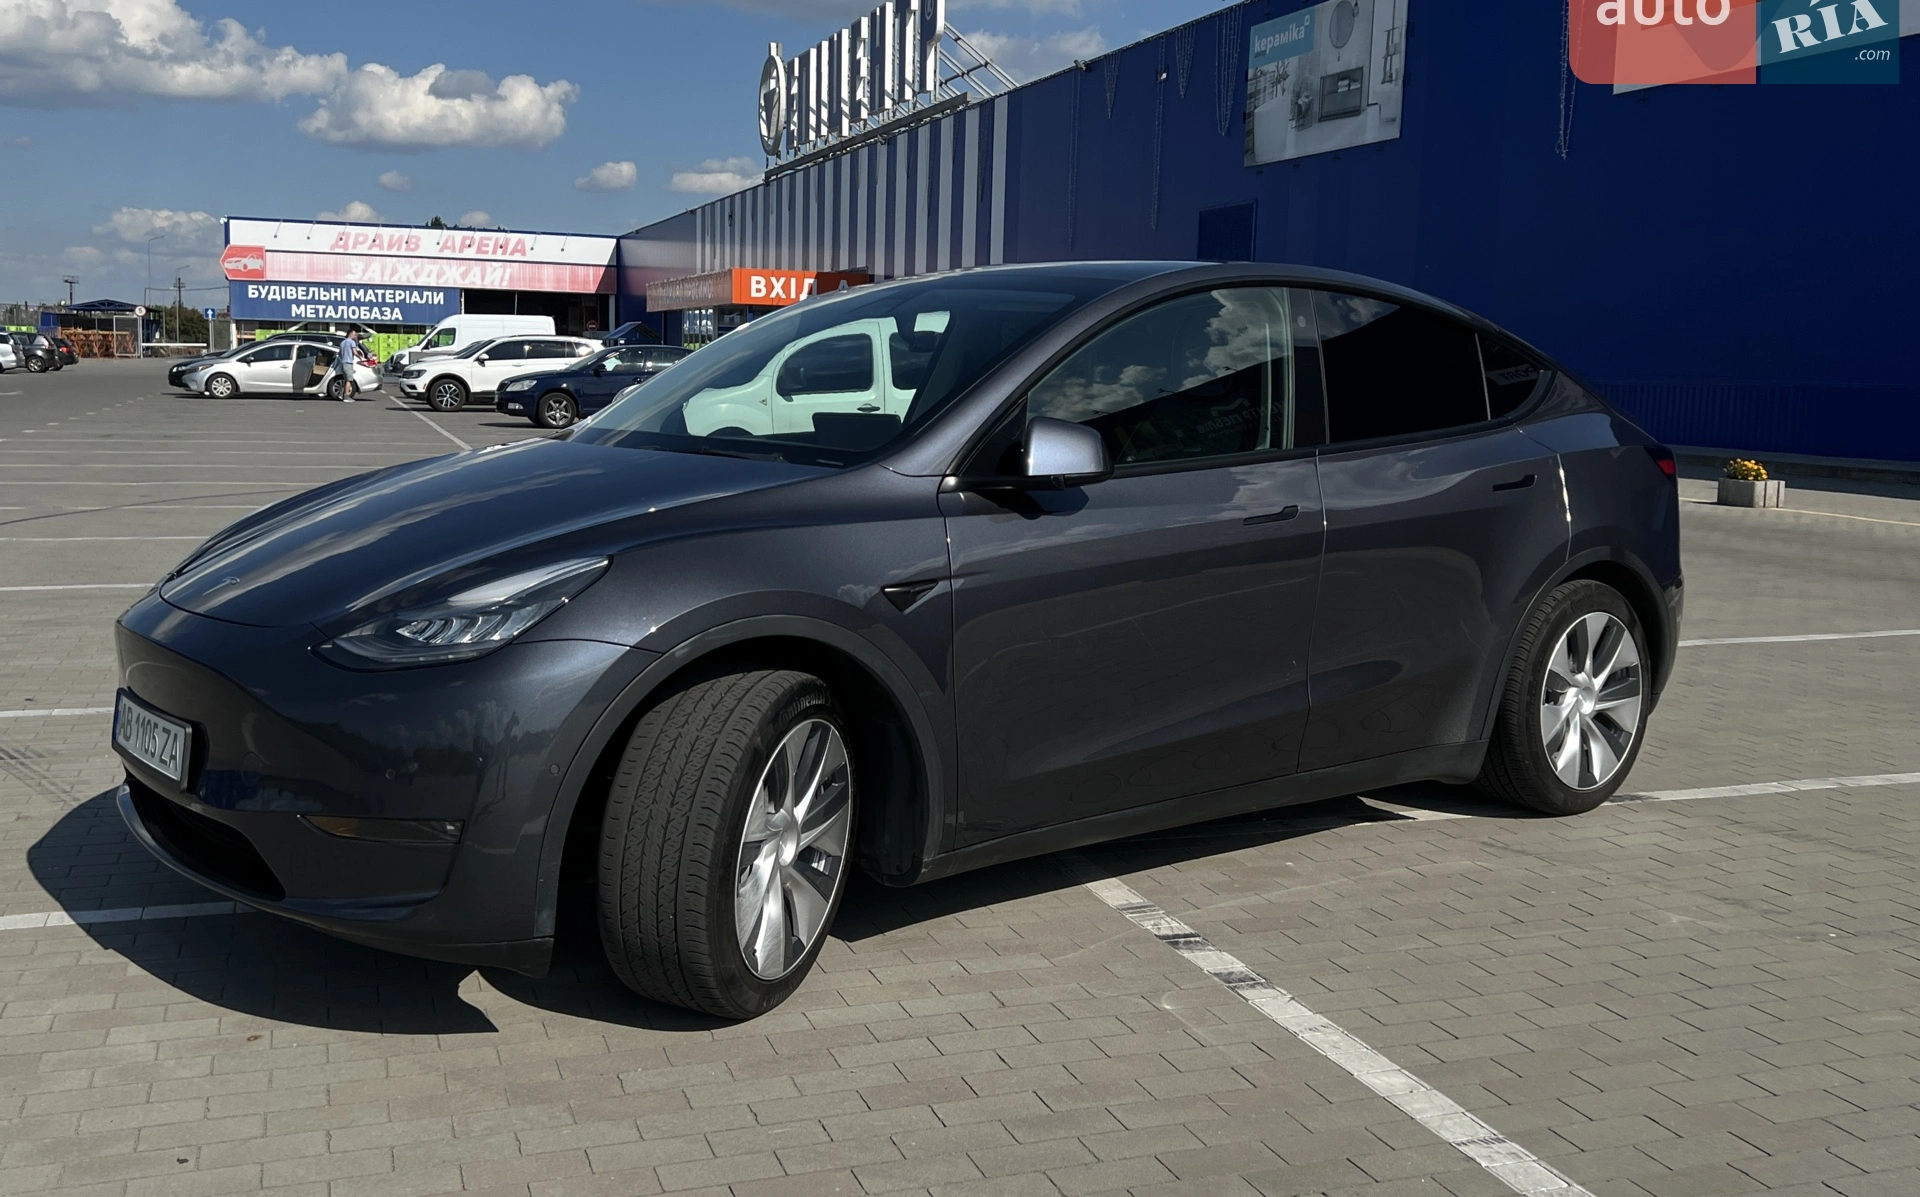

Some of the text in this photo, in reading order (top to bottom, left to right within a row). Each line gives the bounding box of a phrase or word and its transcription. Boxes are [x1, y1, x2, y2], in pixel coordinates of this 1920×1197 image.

[438, 234, 527, 257] АРЕНА
[345, 257, 512, 287] ЗАЇЖДЖАЙ!
[247, 284, 445, 305] БУДІВЕЛЬНІ МАТЕРІАЛИ
[750, 275, 818, 301] ВХІД
[291, 303, 404, 321] МЕТАЛОБАЗА
[779, 689, 826, 728] Continental
[119, 703, 180, 772] AB 1105 ZA
